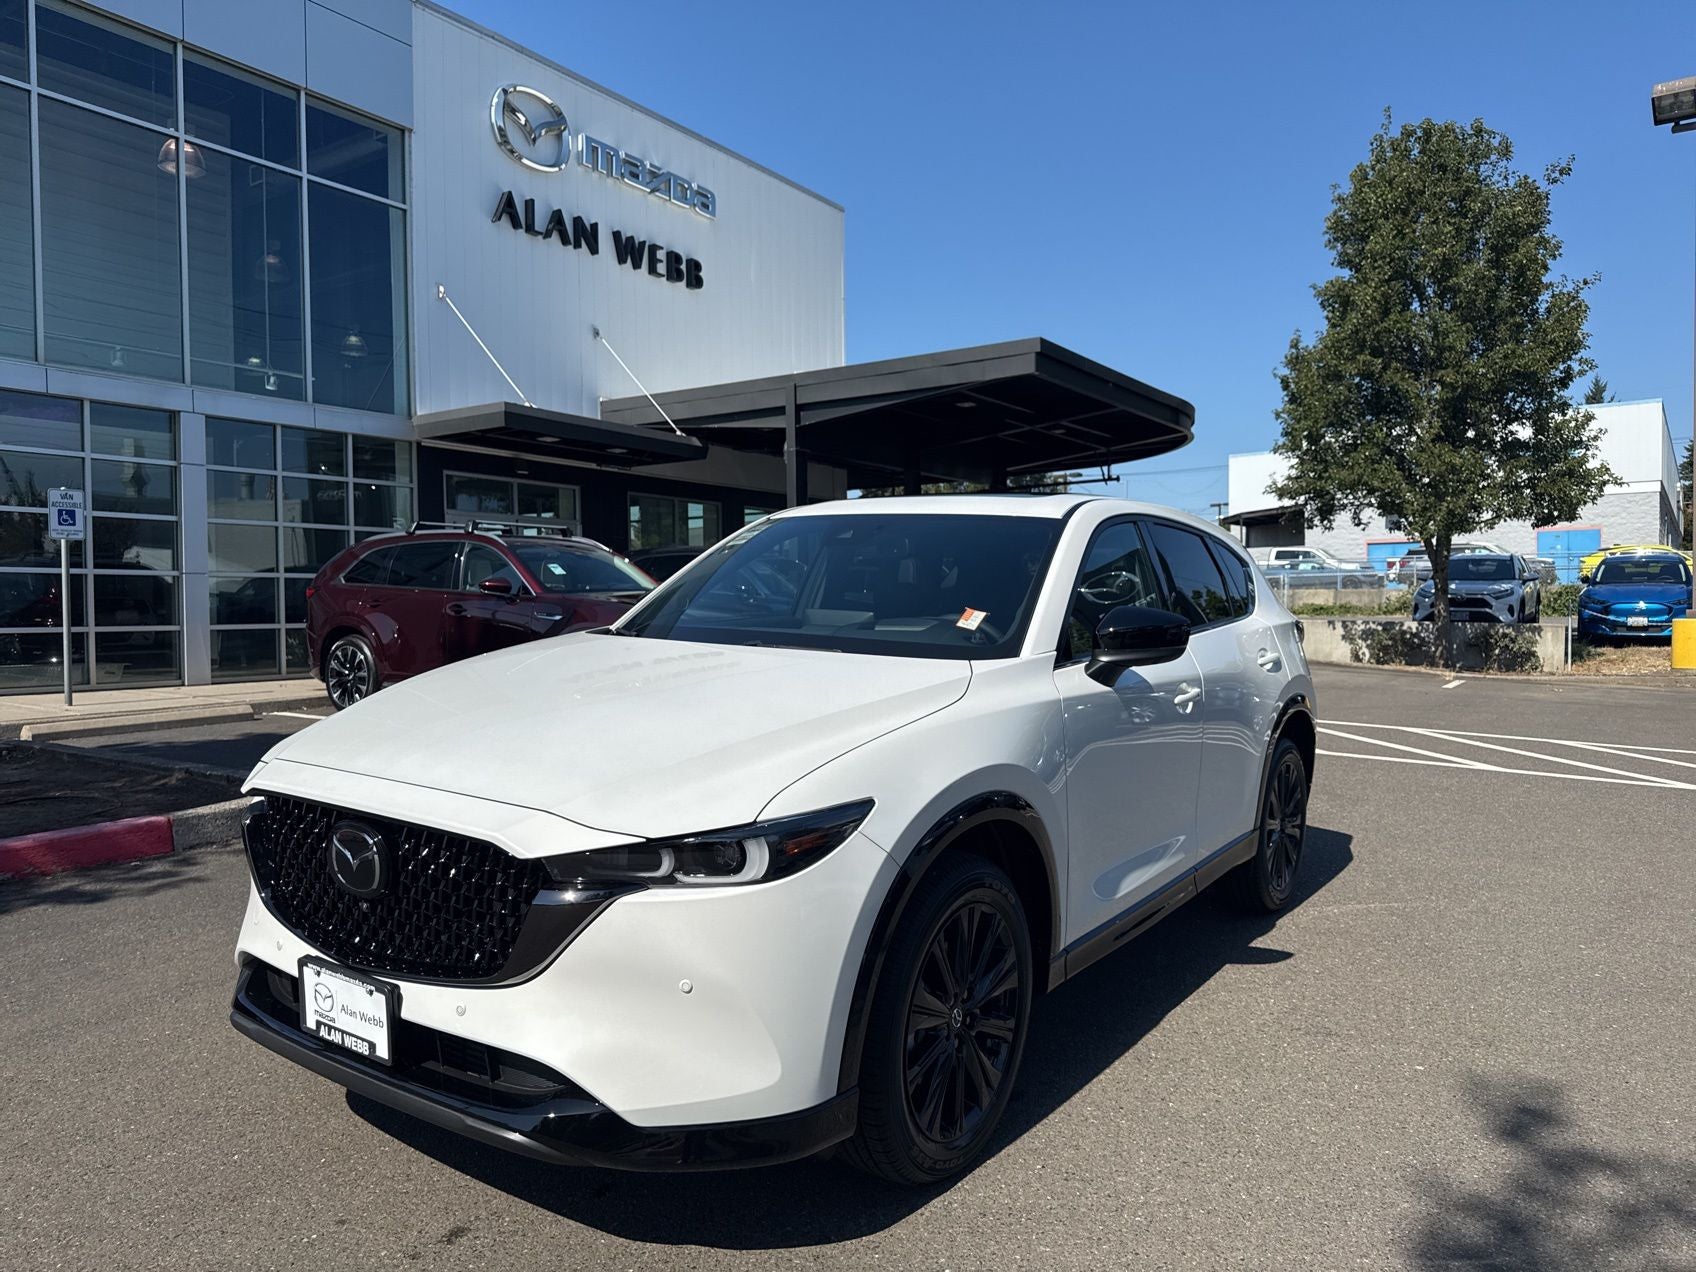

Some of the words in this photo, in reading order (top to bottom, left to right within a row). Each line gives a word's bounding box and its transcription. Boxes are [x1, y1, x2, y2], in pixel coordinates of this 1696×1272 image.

[577, 133, 717, 219] mazda
[491, 190, 600, 256] ALAN
[611, 229, 704, 290] WEBB
[51, 501, 82, 509] ACCESSIBLE
[60, 492, 74, 501] VAN
[314, 1009, 336, 1024] mazda
[340, 1004, 358, 1019] Alan
[358, 1010, 384, 1029] Webb
[319, 1024, 342, 1045] ALAN
[343, 1033, 370, 1056] WEBB
